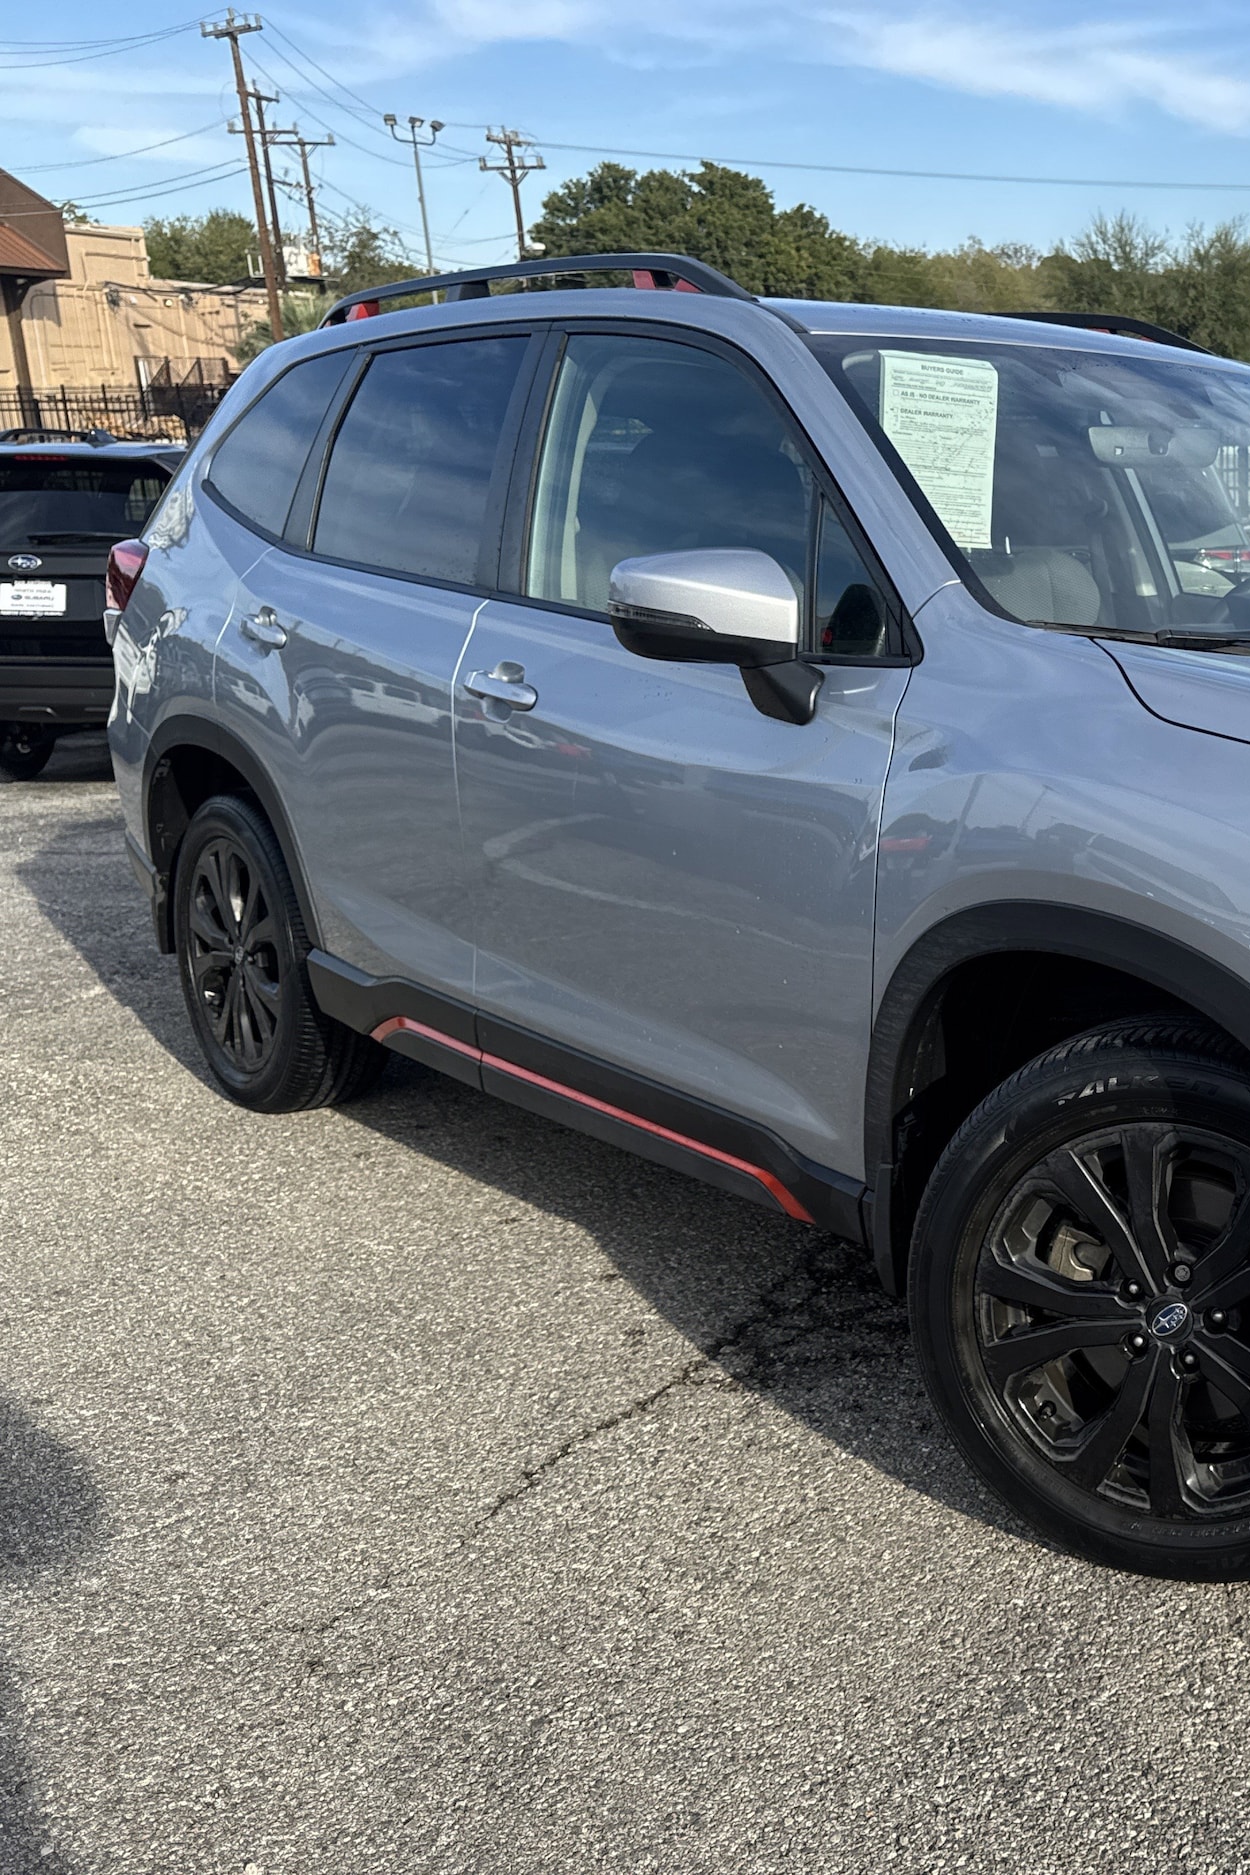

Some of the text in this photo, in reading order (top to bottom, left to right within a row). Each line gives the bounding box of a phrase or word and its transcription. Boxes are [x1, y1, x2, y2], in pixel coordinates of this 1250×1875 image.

[921, 364, 964, 375] BUYERS GUIDE
[928, 393, 950, 402] DEALER
[950, 397, 981, 406] WARRANTY
[900, 407, 953, 419] DEALER WARRANTY
[1051, 1075, 1221, 1106] FALKEN
